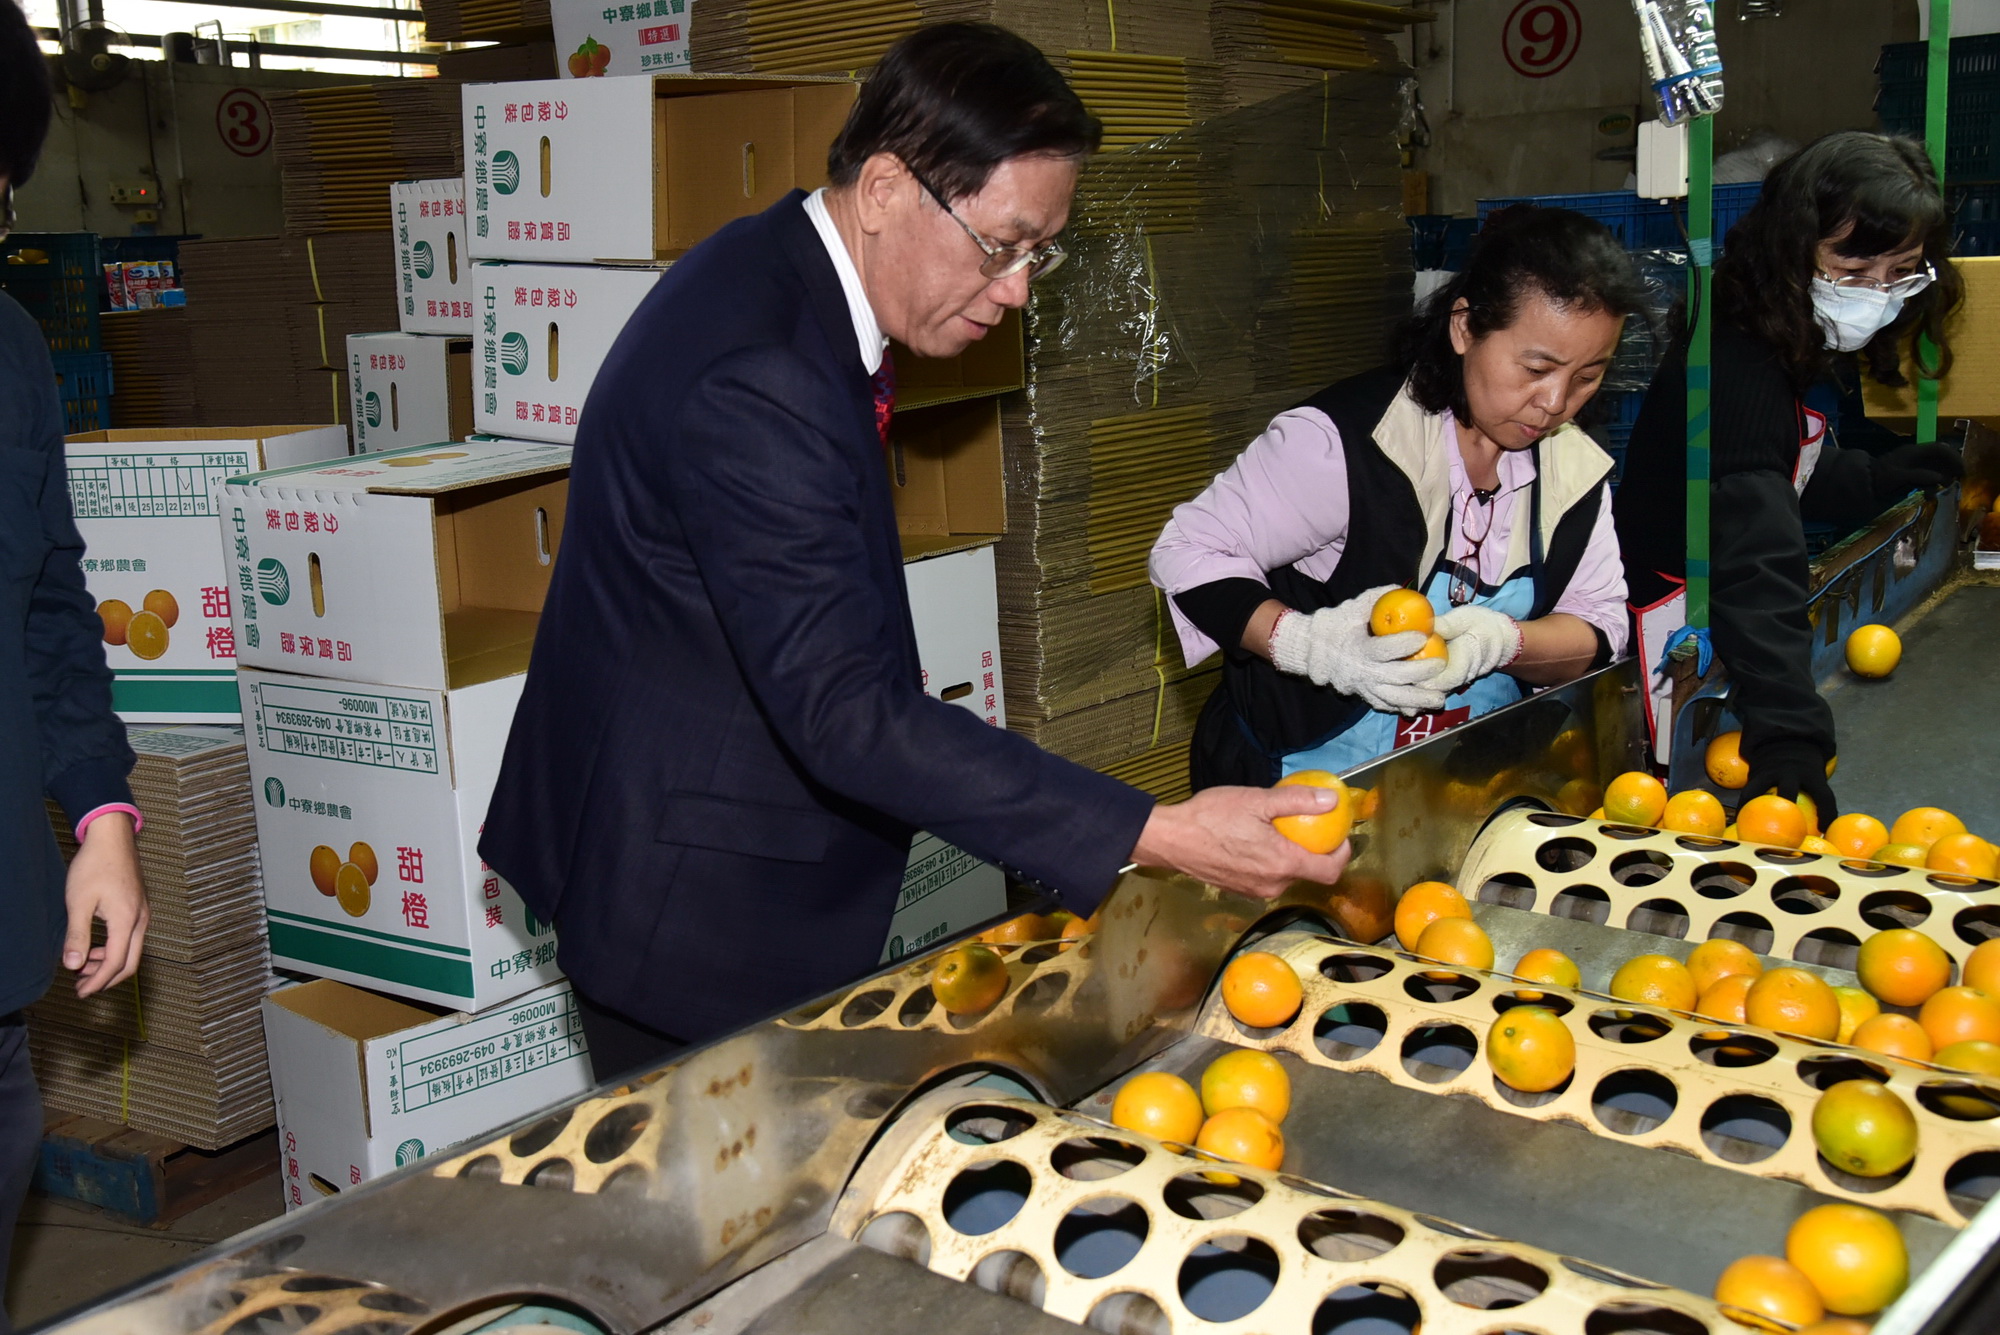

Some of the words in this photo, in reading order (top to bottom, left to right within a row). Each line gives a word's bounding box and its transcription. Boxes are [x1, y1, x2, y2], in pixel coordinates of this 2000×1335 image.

[603, 0, 685, 24] 中寮鄉農會
[1520, 5, 1567, 67] 9
[228, 101, 260, 147] 3
[504, 100, 568, 123] 分級包裝
[474, 105, 489, 239] 中寮鄉農會
[508, 220, 570, 241] 品質保證
[398, 202, 415, 317] 中寮鄉農會
[514, 286, 578, 309] 分級包裝
[483, 286, 497, 416] 中寮鄉農會
[515, 400, 578, 426] 品質保證
[141, 503, 151, 511] 25
[155, 502, 165, 511] 23
[169, 502, 178, 511] 22
[183, 502, 192, 511] 21
[197, 502, 206, 511] 19
[265, 508, 339, 535] 分級包裝
[232, 507, 260, 649] 中寮鄉農會
[201, 586, 237, 660] 甜橙
[280, 631, 352, 662] 品質保證
[288, 797, 352, 820] 中寮鄉農會
[397, 847, 429, 929] 甜橙
